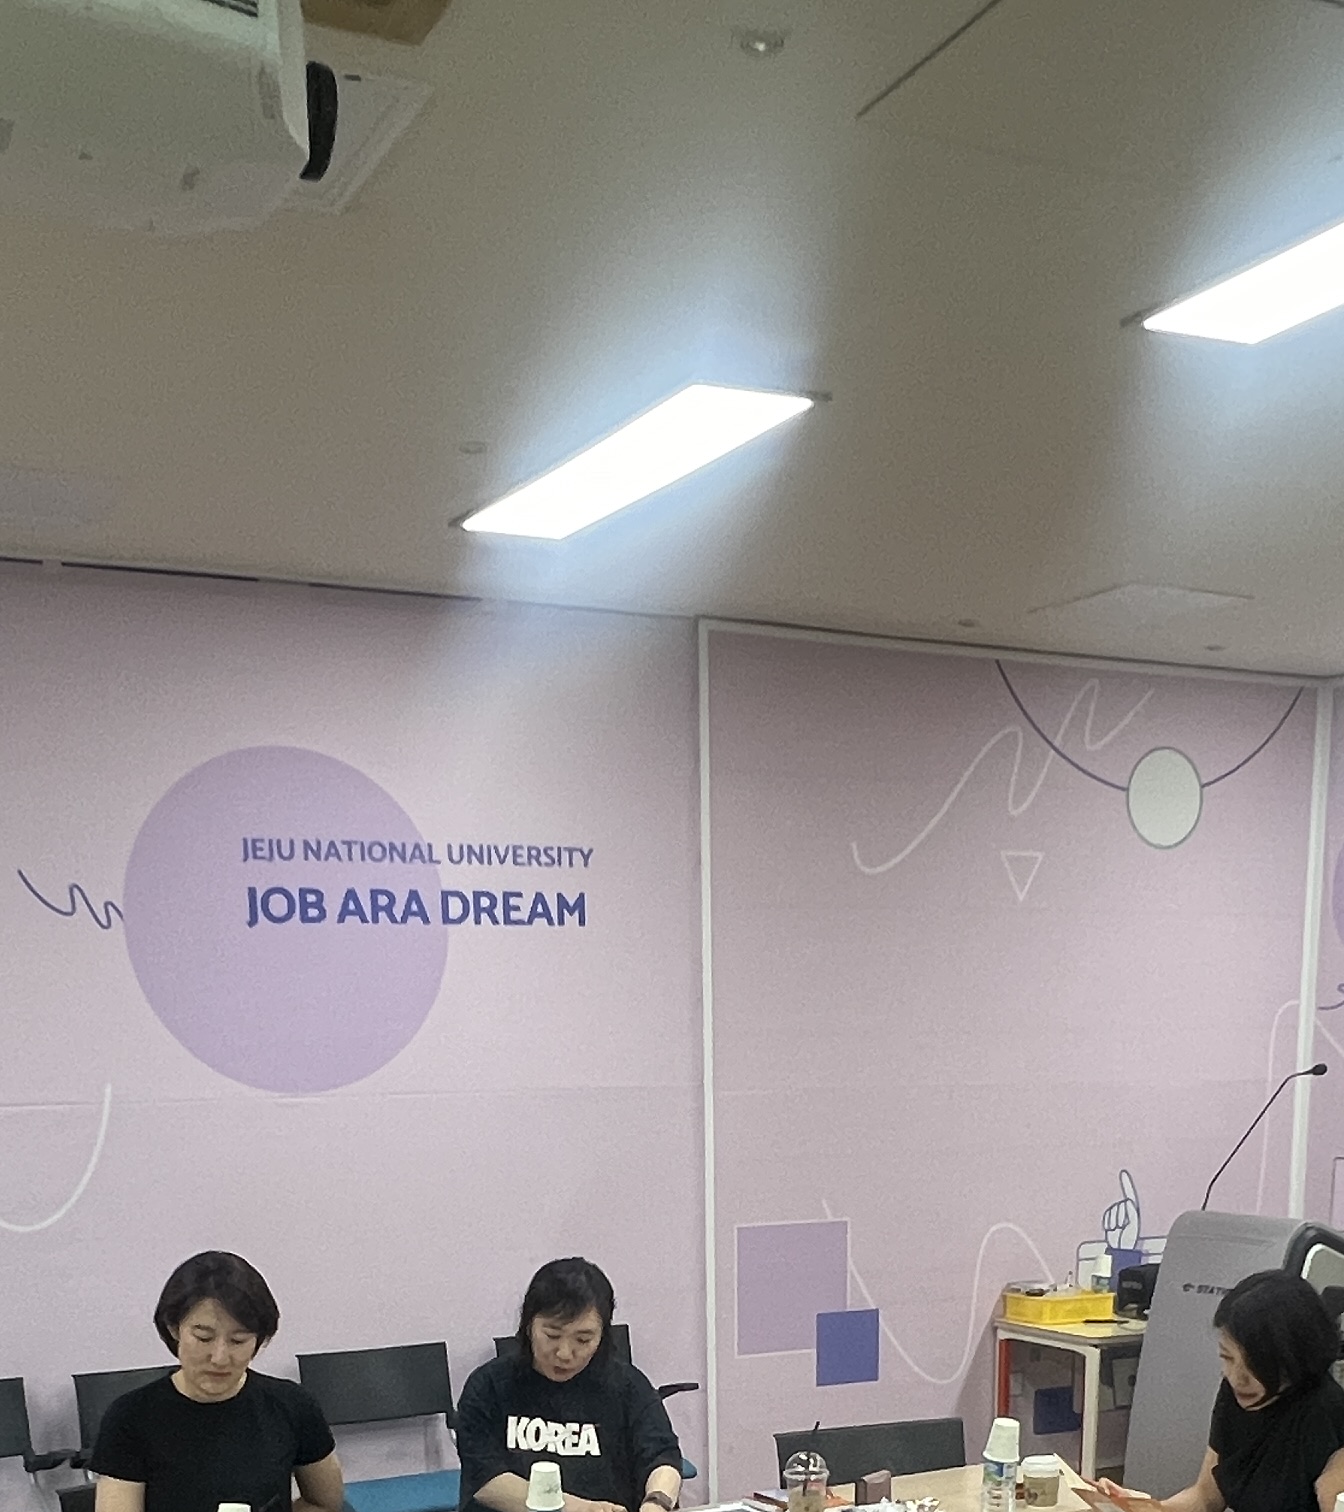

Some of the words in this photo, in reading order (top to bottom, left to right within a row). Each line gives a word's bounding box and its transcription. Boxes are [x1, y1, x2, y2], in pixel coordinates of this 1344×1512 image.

[242, 837, 295, 863] JEJU
[302, 838, 441, 865] NATIONAL
[447, 843, 594, 868] UNIVERSITY
[247, 886, 327, 928] JOB
[336, 887, 431, 925] ARA
[441, 889, 586, 927] DREAM
[507, 1415, 602, 1456] KOREA
